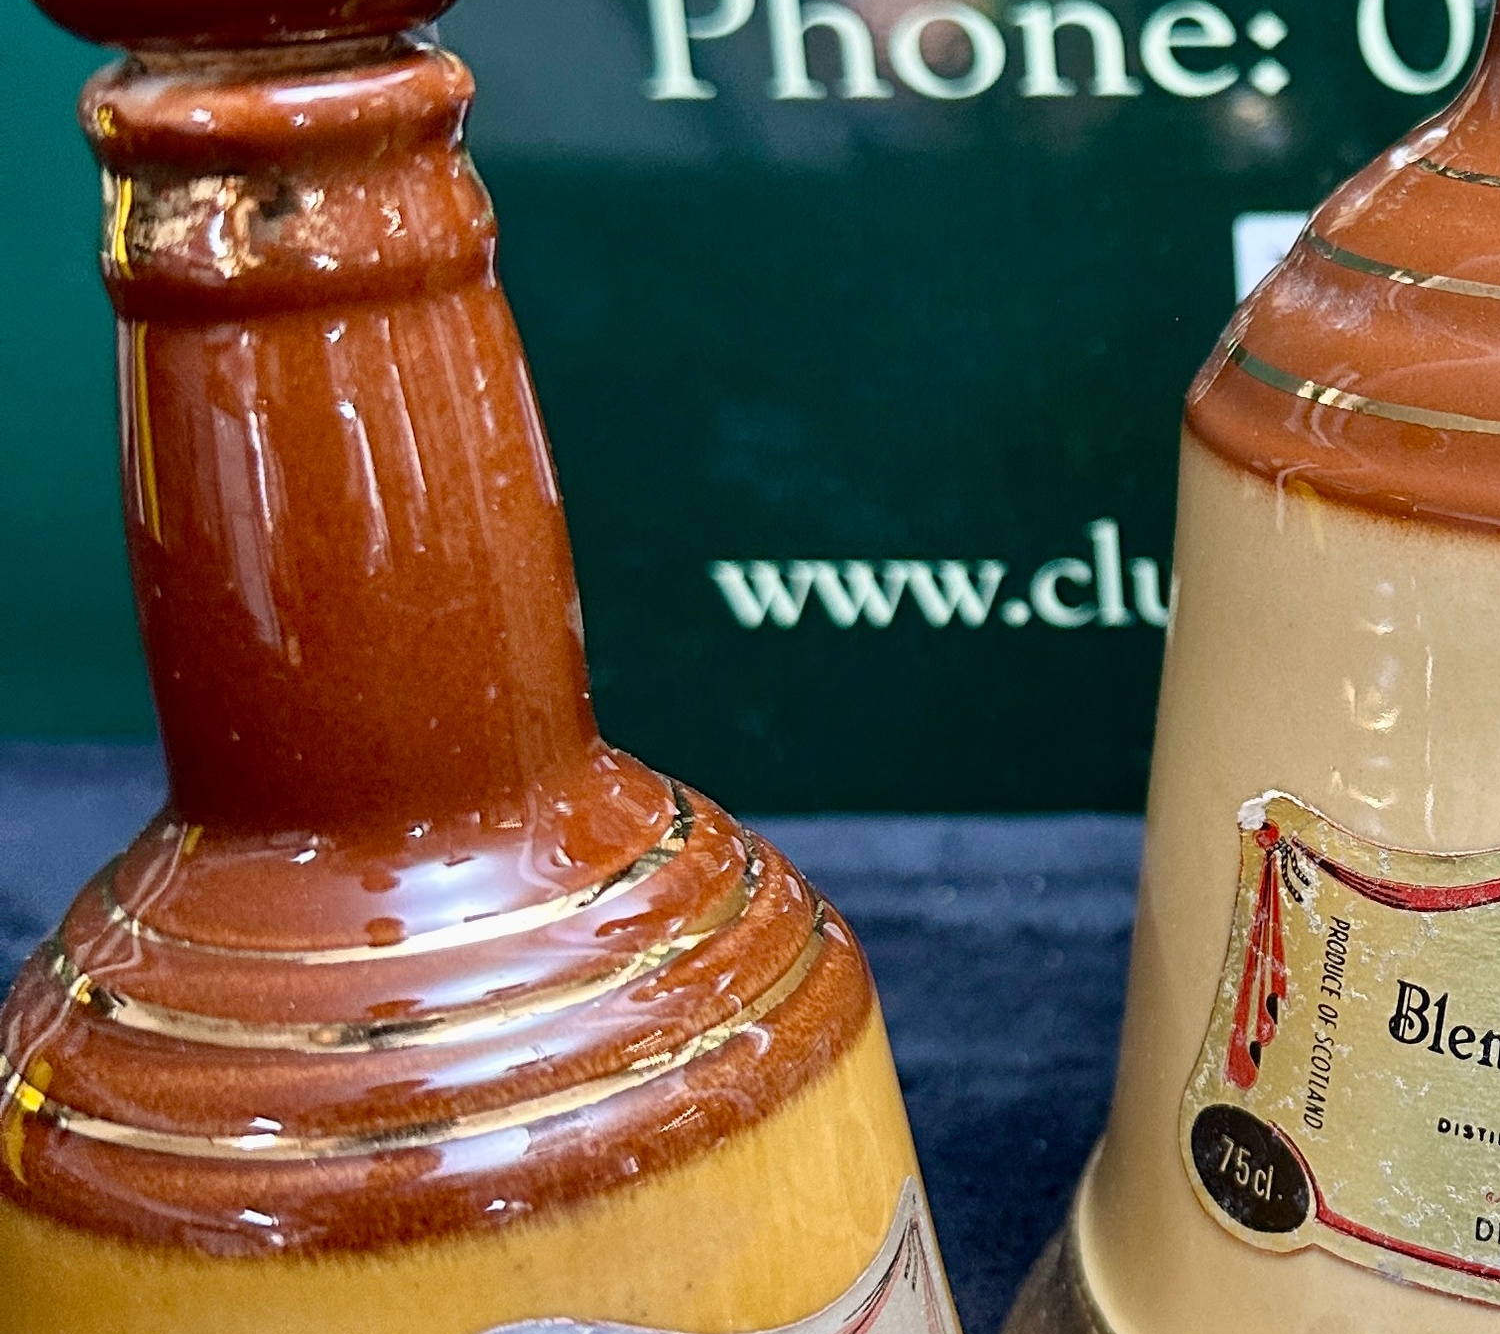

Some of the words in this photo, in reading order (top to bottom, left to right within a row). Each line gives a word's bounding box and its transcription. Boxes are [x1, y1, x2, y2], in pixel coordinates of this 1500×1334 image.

[1317, 916, 1351, 1001] PRODUCE
[1317, 1004, 1339, 1029] OF
[1303, 1032, 1335, 1131] SCOTLAND
